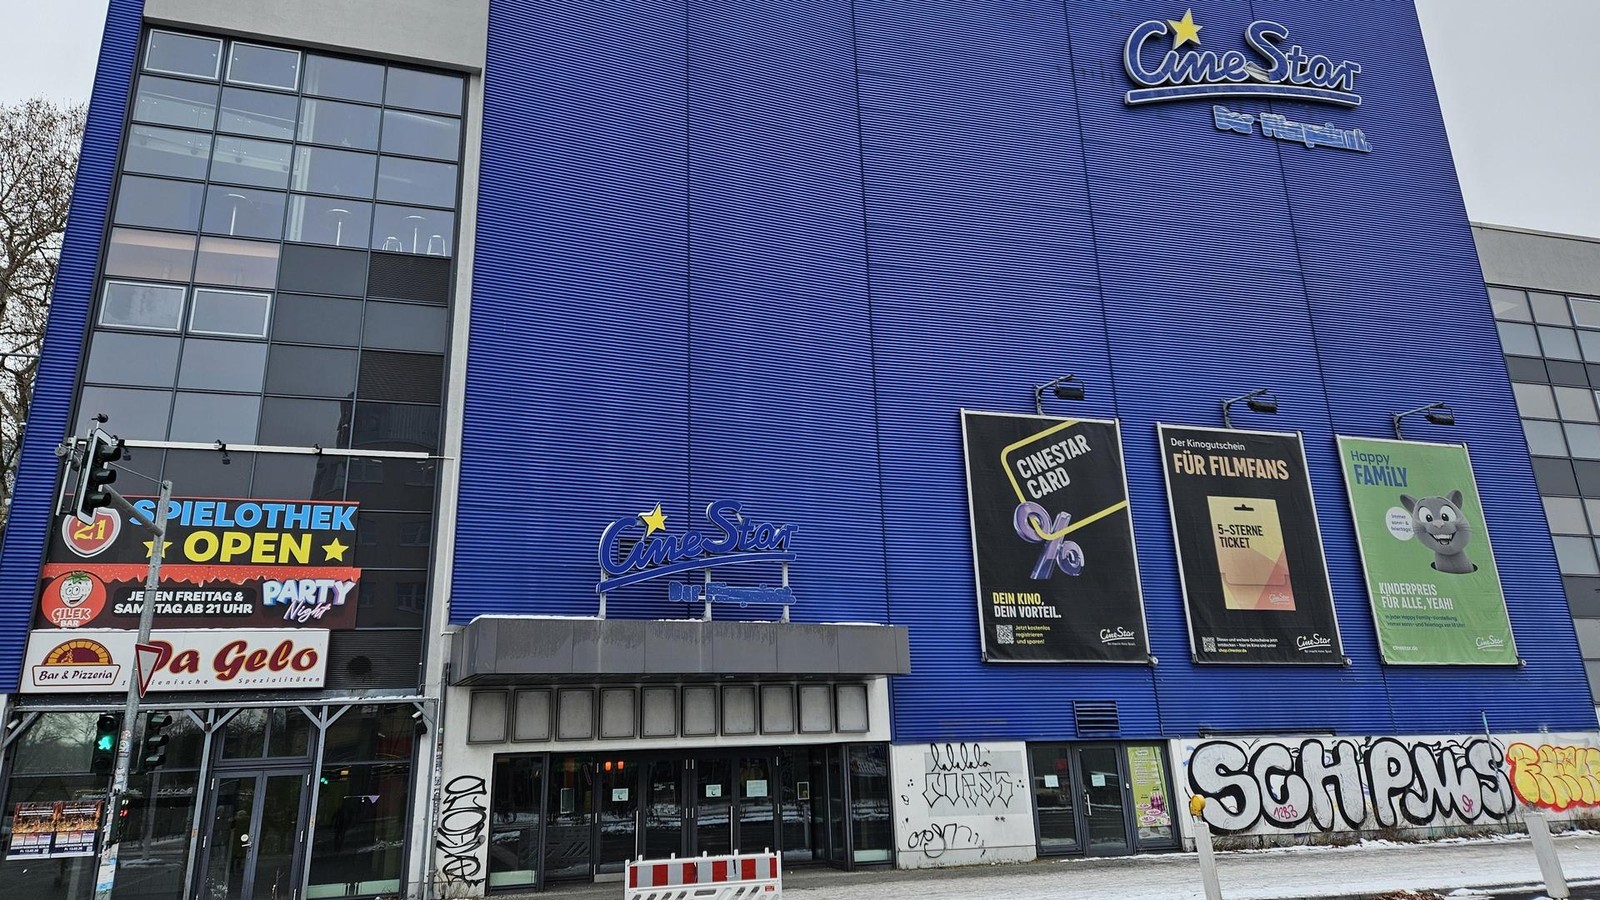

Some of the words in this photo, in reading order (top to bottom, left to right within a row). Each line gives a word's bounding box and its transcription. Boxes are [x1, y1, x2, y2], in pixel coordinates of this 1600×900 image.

[1170, 437, 1186, 447] Der
[1186, 438, 1246, 451] Kinogutschein
[1016, 434, 1092, 479] CINESTAR
[1350, 450, 1390, 466] Happy
[1173, 449, 1207, 476] FÜR
[1208, 455, 1290, 480] FILMFANS
[1026, 466, 1071, 499] CARD
[73, 519, 107, 540] 21
[1217, 523, 1264, 536] 5-STERNE
[183, 530, 313, 564] OPEN
[1219, 536, 1250, 549] TICKET
[262, 579, 357, 606] PARTY
[1379, 582, 1438, 596] KINDERPREIS
[127, 591, 173, 602] JEEN
[175, 591, 232, 602] FREITAG
[233, 591, 244, 602] &
[992, 592, 1015, 605] DEIN
[1016, 593, 1045, 606] KINO,
[1381, 594, 1400, 608] FÜR
[1402, 596, 1427, 610] ALLE,
[1426, 597, 1454, 610] YEAH!
[113, 603, 182, 614] SAMTAG
[183, 603, 204, 614] AB
[205, 603, 221, 614] 21
[222, 603, 253, 614] UHR
[283, 600, 332, 623] Night
[993, 605, 1017, 618] DEIN
[1018, 605, 1062, 619] VORTEIL.
[60, 619, 80, 628] BAR
[213, 639, 319, 682] Gelo
[39, 670, 59, 681] Bar
[61, 670, 69, 680] &
[71, 669, 113, 680] Pizzeria
[238, 676, 320, 684] Spezialitäten
